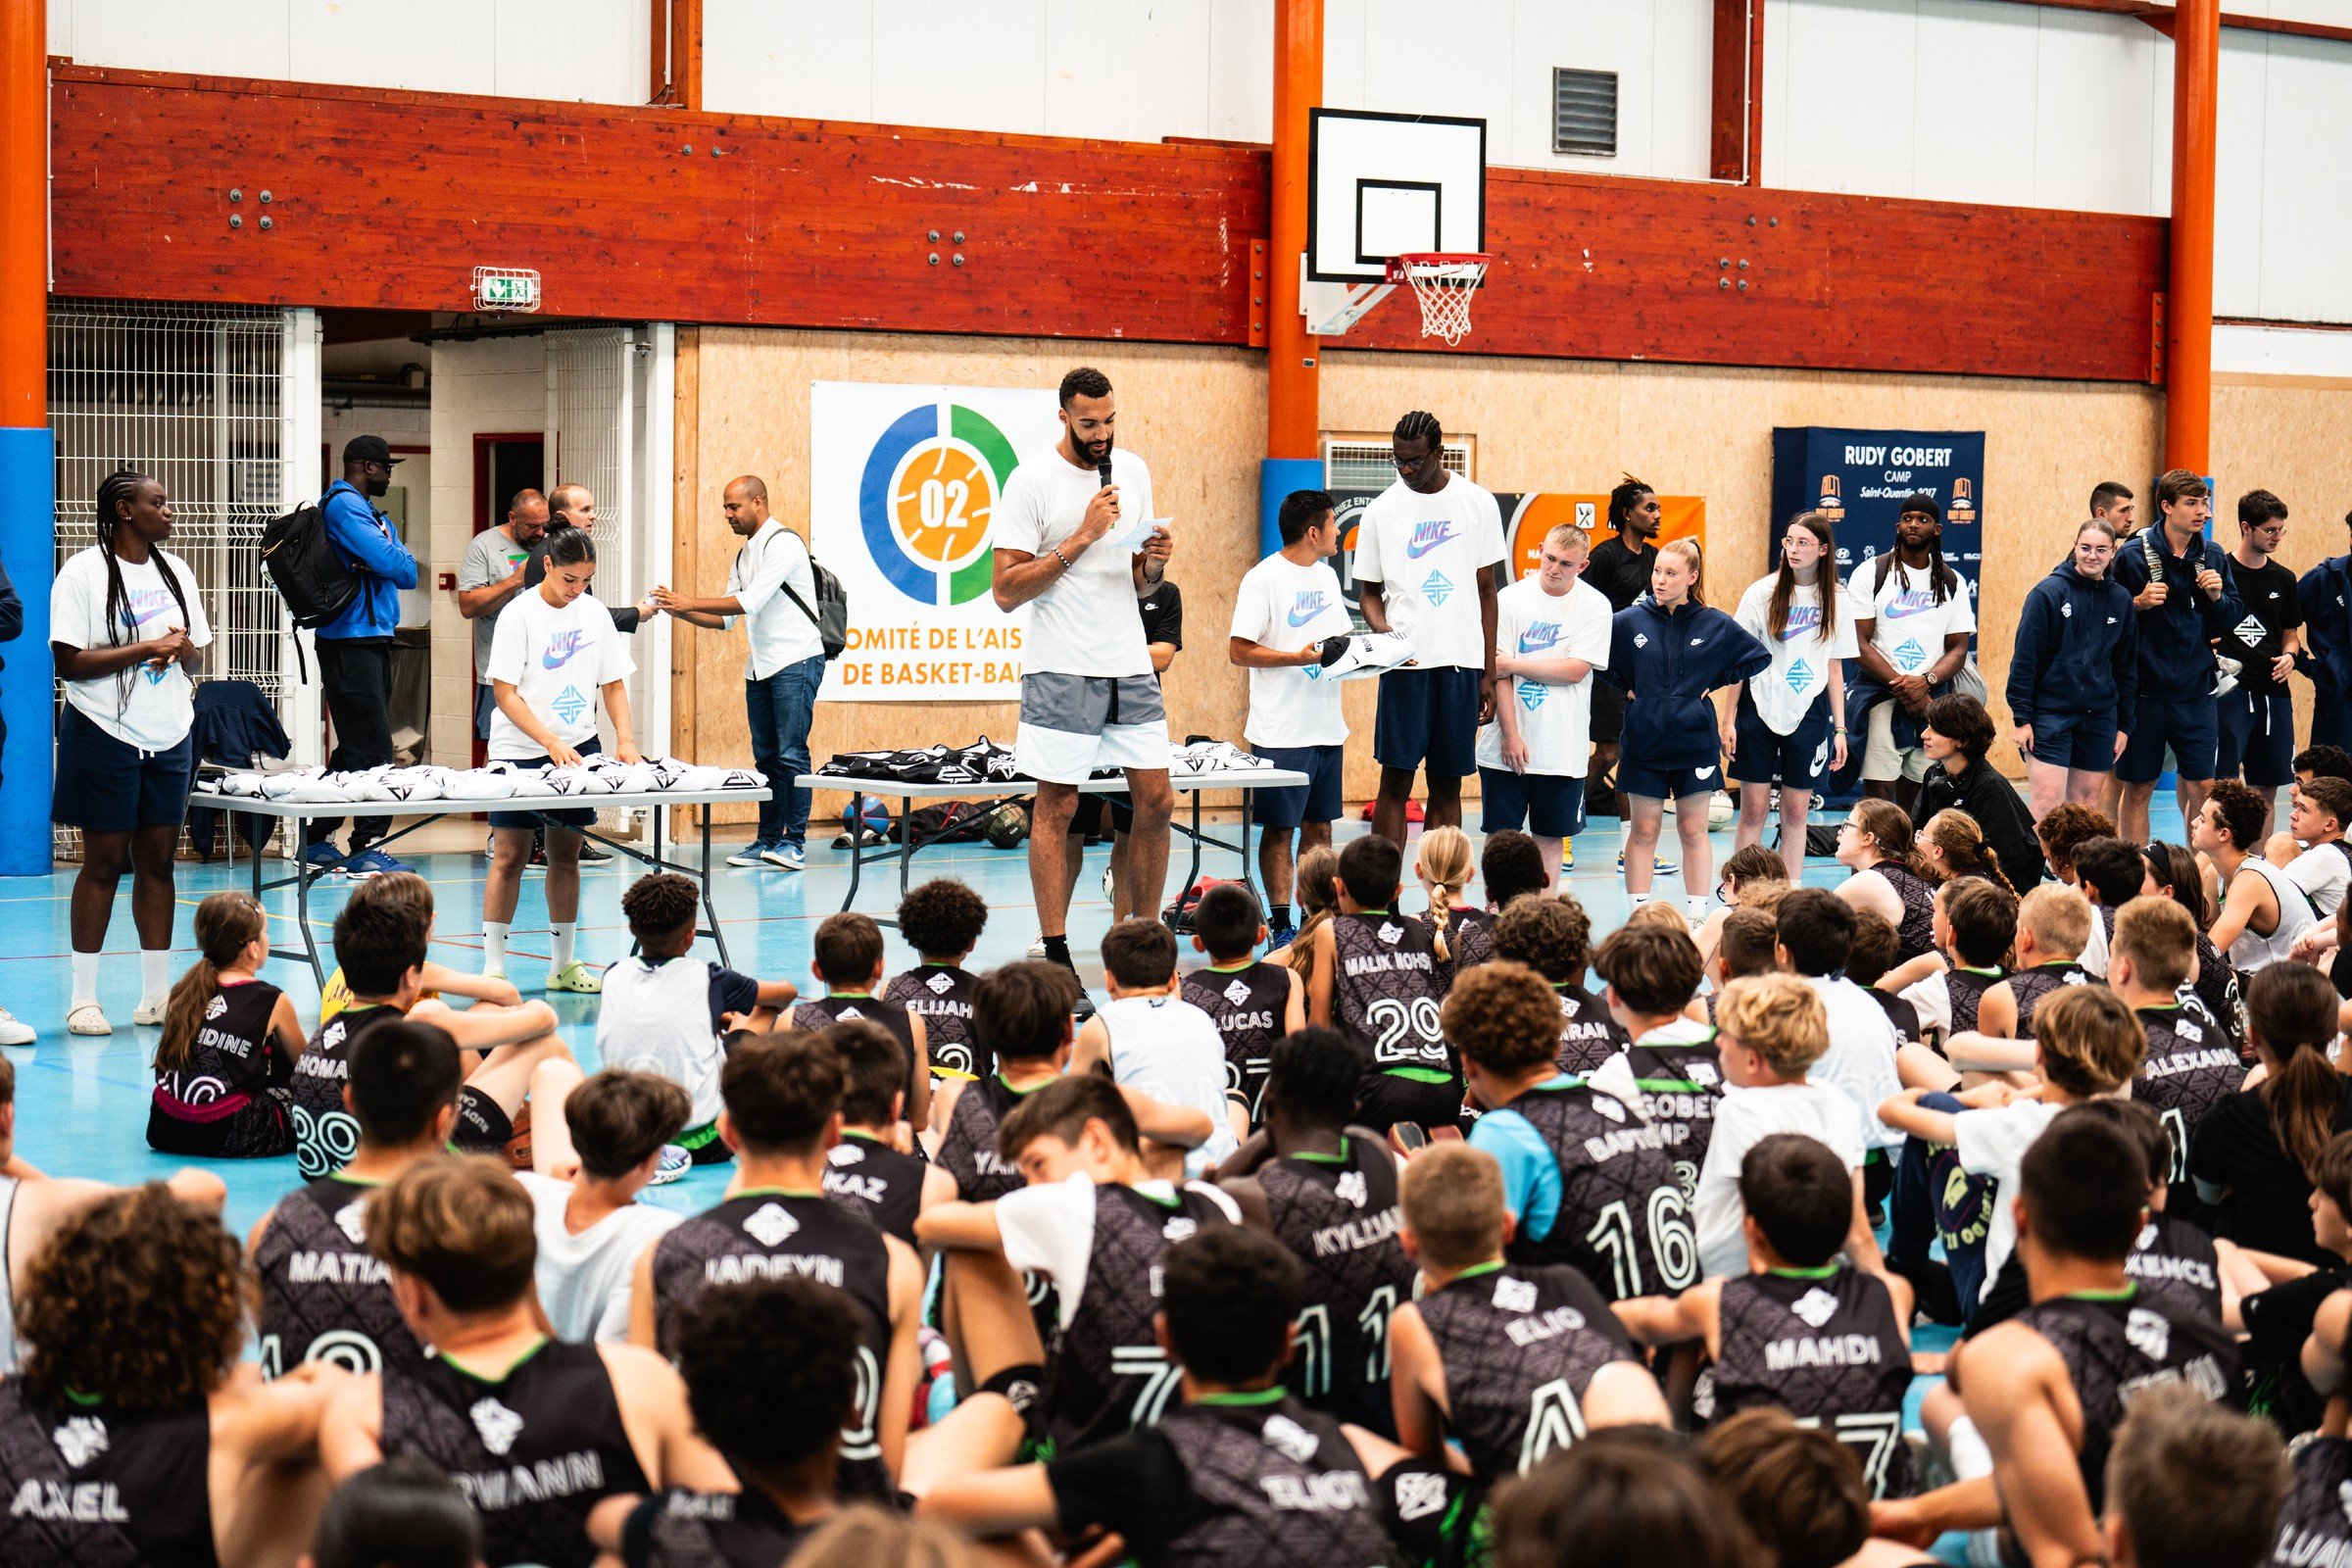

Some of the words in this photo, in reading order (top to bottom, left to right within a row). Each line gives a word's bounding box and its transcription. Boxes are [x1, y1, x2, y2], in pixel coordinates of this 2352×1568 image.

[1844, 445, 1886, 466] RUDY
[1890, 446, 1952, 466] GOBERT
[1884, 470, 1912, 483] CAMP
[920, 478, 968, 527] 02
[1414, 520, 1451, 542] NIKE
[129, 589, 169, 608] NIKE
[1296, 591, 1324, 611] NIKE
[1895, 588, 1934, 608] NIKE
[1788, 607, 1822, 625] NIKE
[845, 621, 920, 650] OMITÉ
[929, 628, 957, 650] DE
[965, 627, 1022, 650] L'AIS
[1525, 620, 1562, 640] NIKE
[843, 663, 873, 685] DE
[880, 662, 1022, 685] BASKET-BA
[1345, 953, 1393, 977] MALIK
[906, 1000, 973, 1019] ELIJAH
[1211, 1010, 1273, 1032] LUCAS
[1366, 997, 1447, 1062] 29
[294, 1054, 351, 1079] HOMA
[2145, 1048, 2240, 1080] ALEXAND
[1641, 1094, 1716, 1118] GOBE
[820, 1168, 888, 1203] KAZ
[1586, 1186, 1697, 1299] 16
[288, 1250, 394, 1284] MATIA
[1504, 1305, 1587, 1347] ELIO
[1765, 1334, 1882, 1370] MAHDI
[9, 1477, 130, 1522] AXEL
